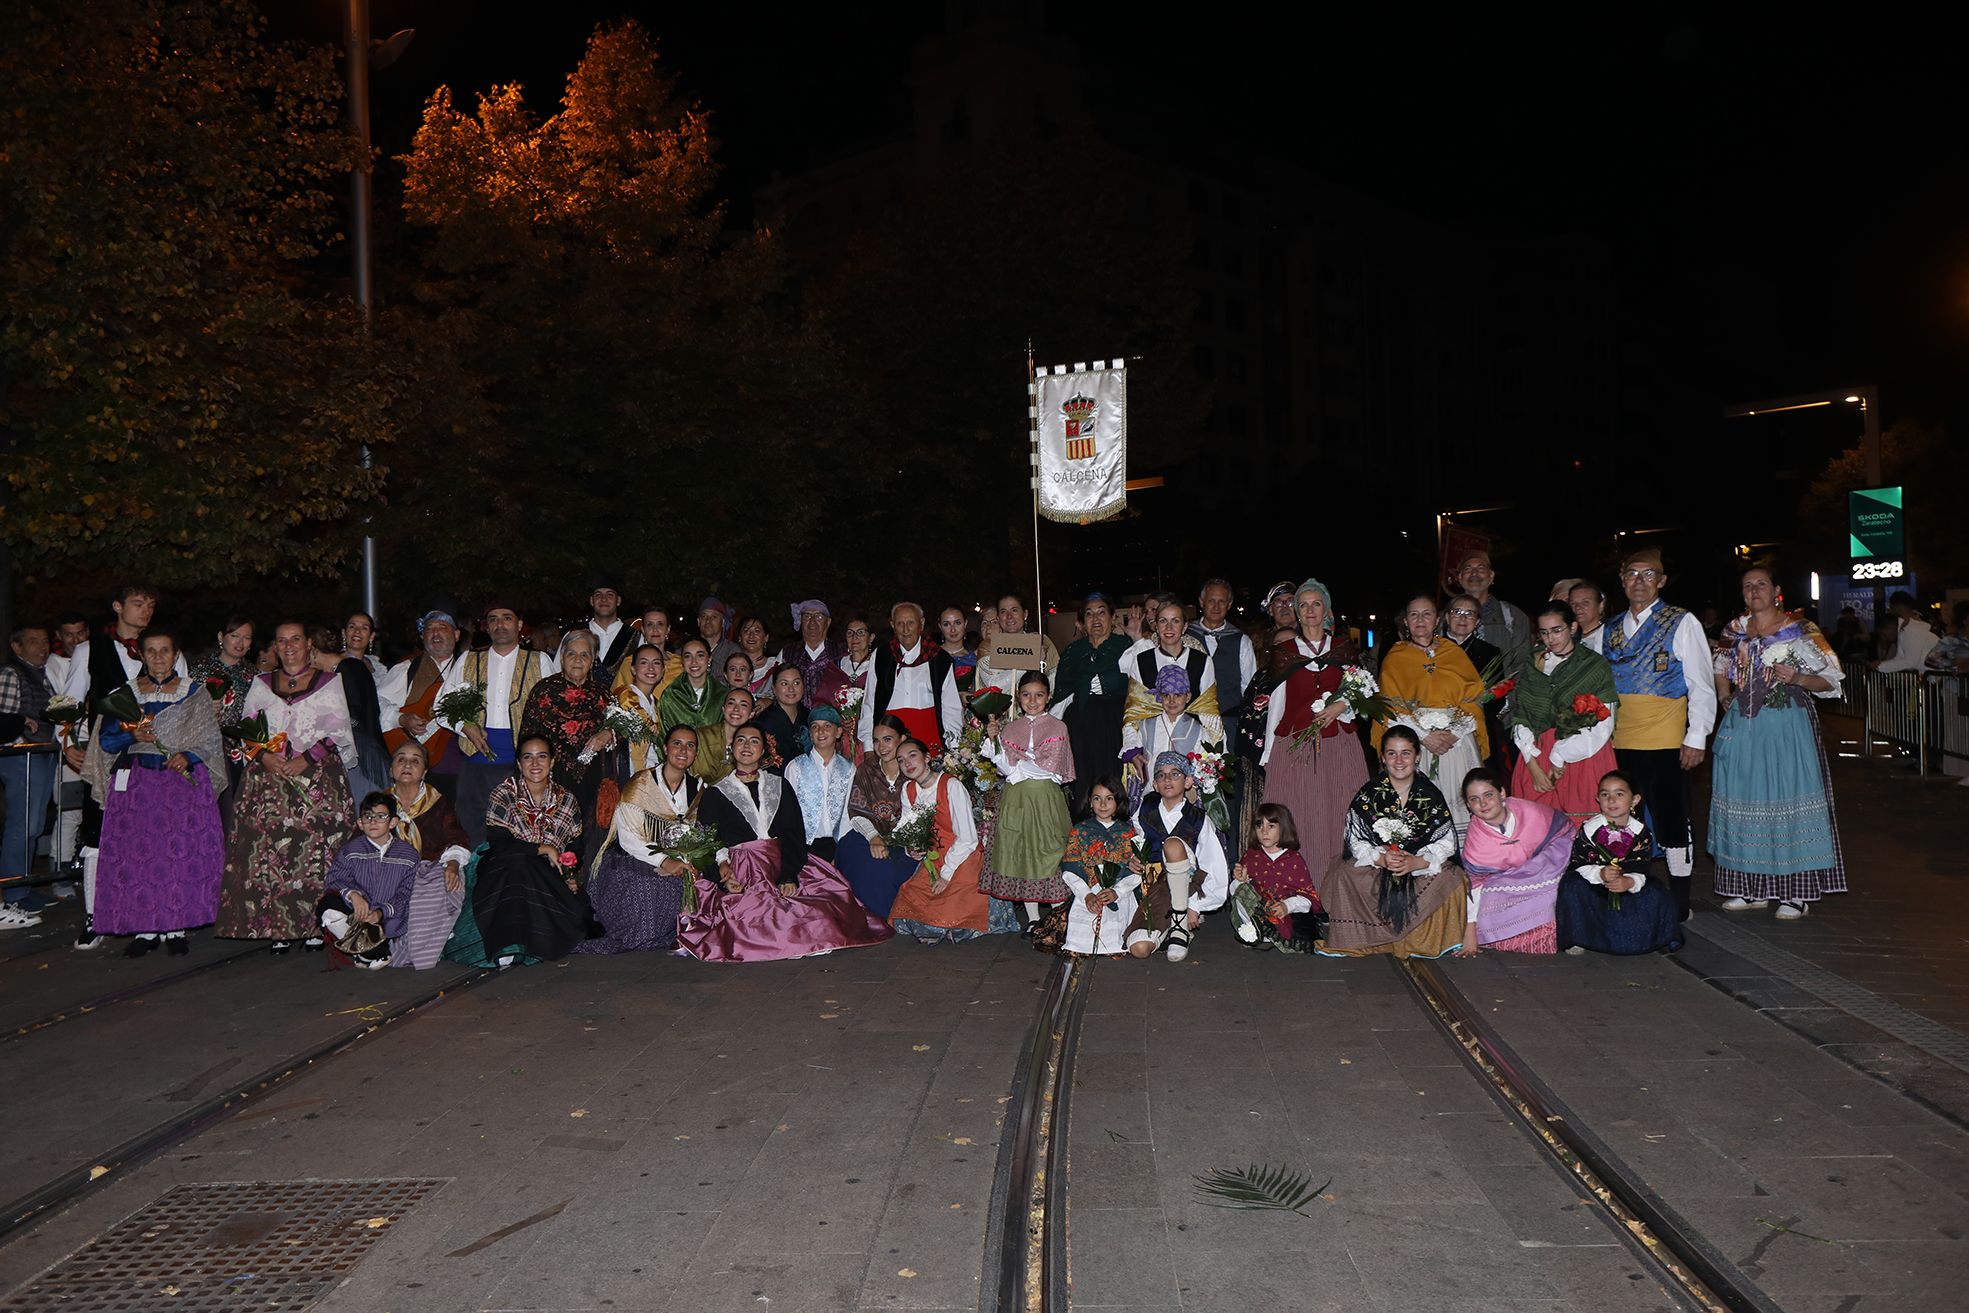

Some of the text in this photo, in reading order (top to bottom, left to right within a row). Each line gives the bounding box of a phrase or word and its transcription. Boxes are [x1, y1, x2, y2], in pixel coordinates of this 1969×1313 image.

[1053, 468, 1107, 483] CALCENA
[1852, 561, 1903, 580] 23:28
[997, 647, 1034, 656] CALCENA
